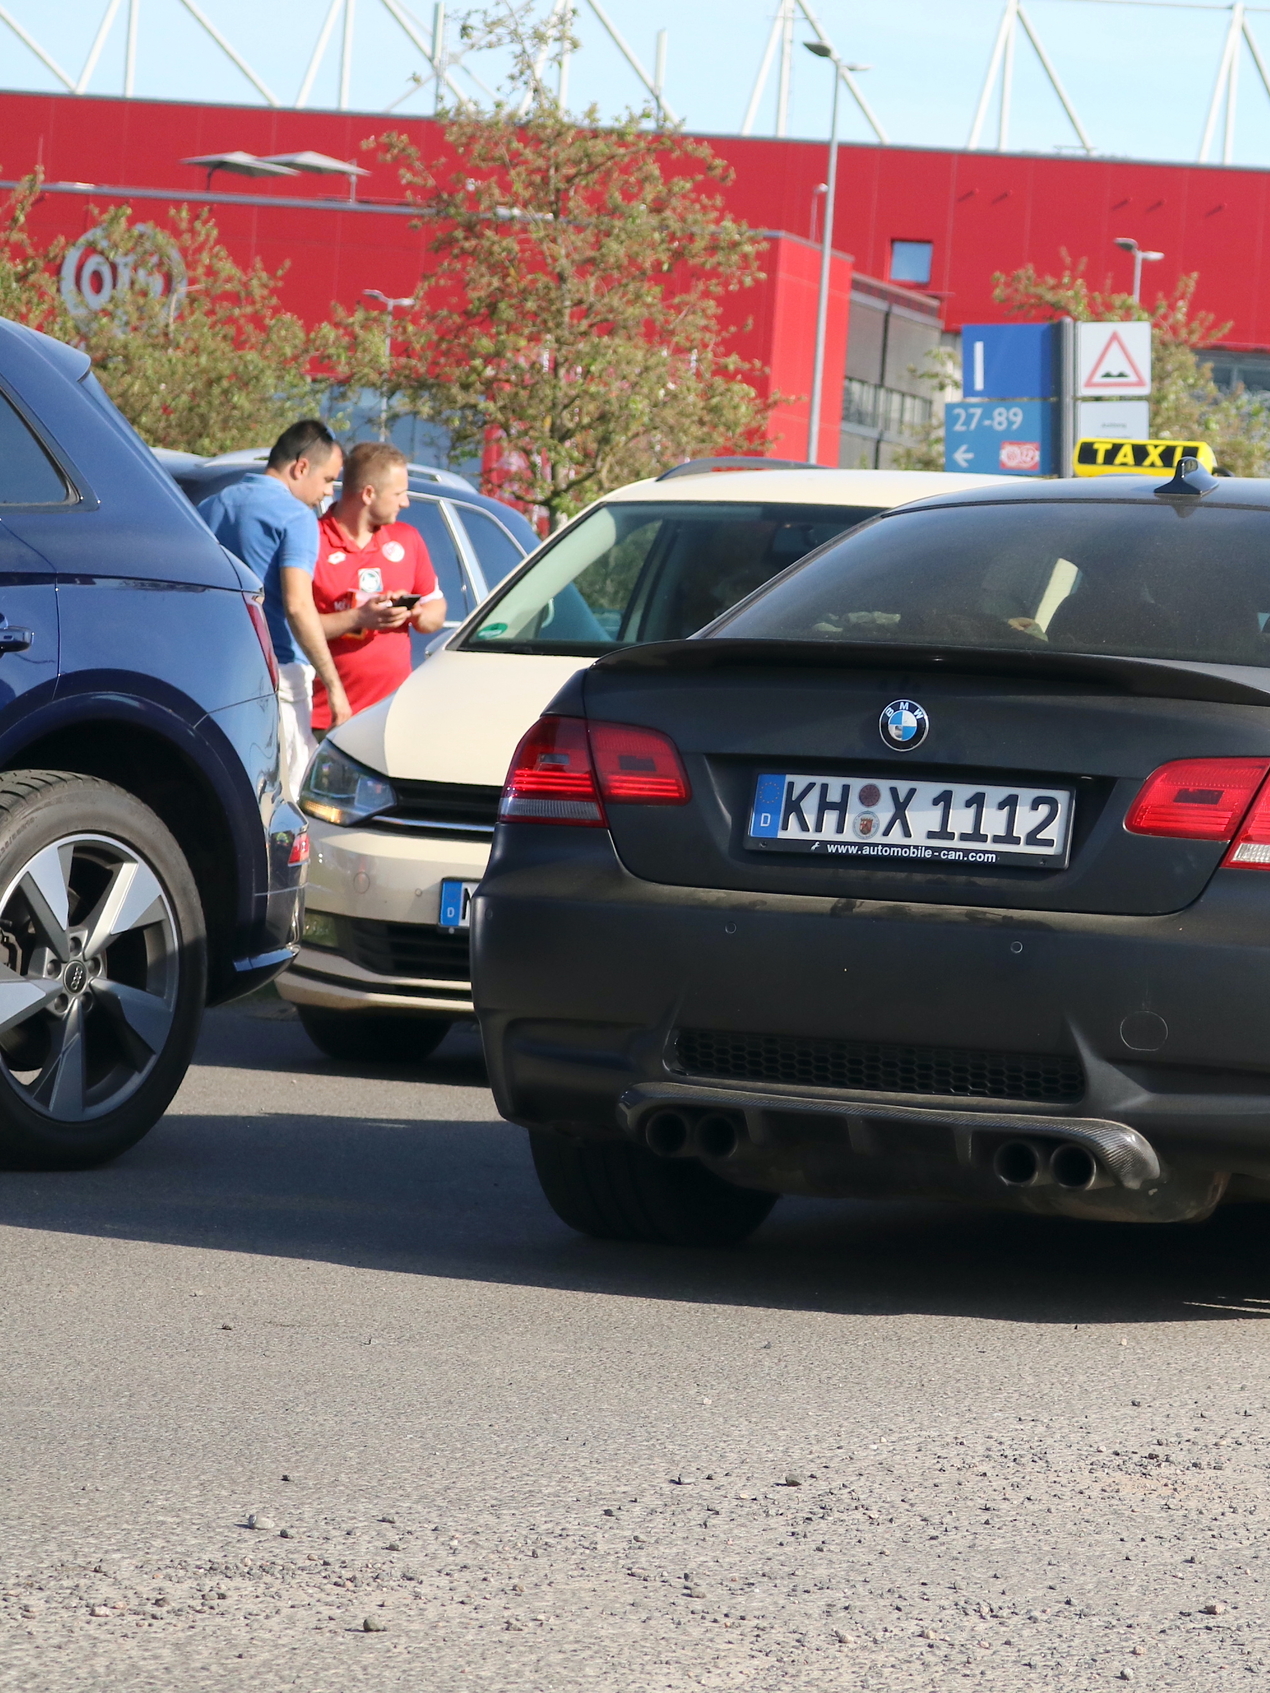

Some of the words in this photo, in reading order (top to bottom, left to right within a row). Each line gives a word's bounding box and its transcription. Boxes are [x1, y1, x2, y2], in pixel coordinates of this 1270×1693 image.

[952, 407, 1023, 432] 27-89
[1093, 442, 1184, 468] TAXI
[885, 701, 924, 720] BMW
[760, 812, 771, 827] D
[781, 781, 851, 834] KH
[882, 787, 918, 838] X
[926, 789, 1059, 848] 1112
[827, 844, 997, 863] www.automobile-can.com
[447, 906, 455, 918] D
